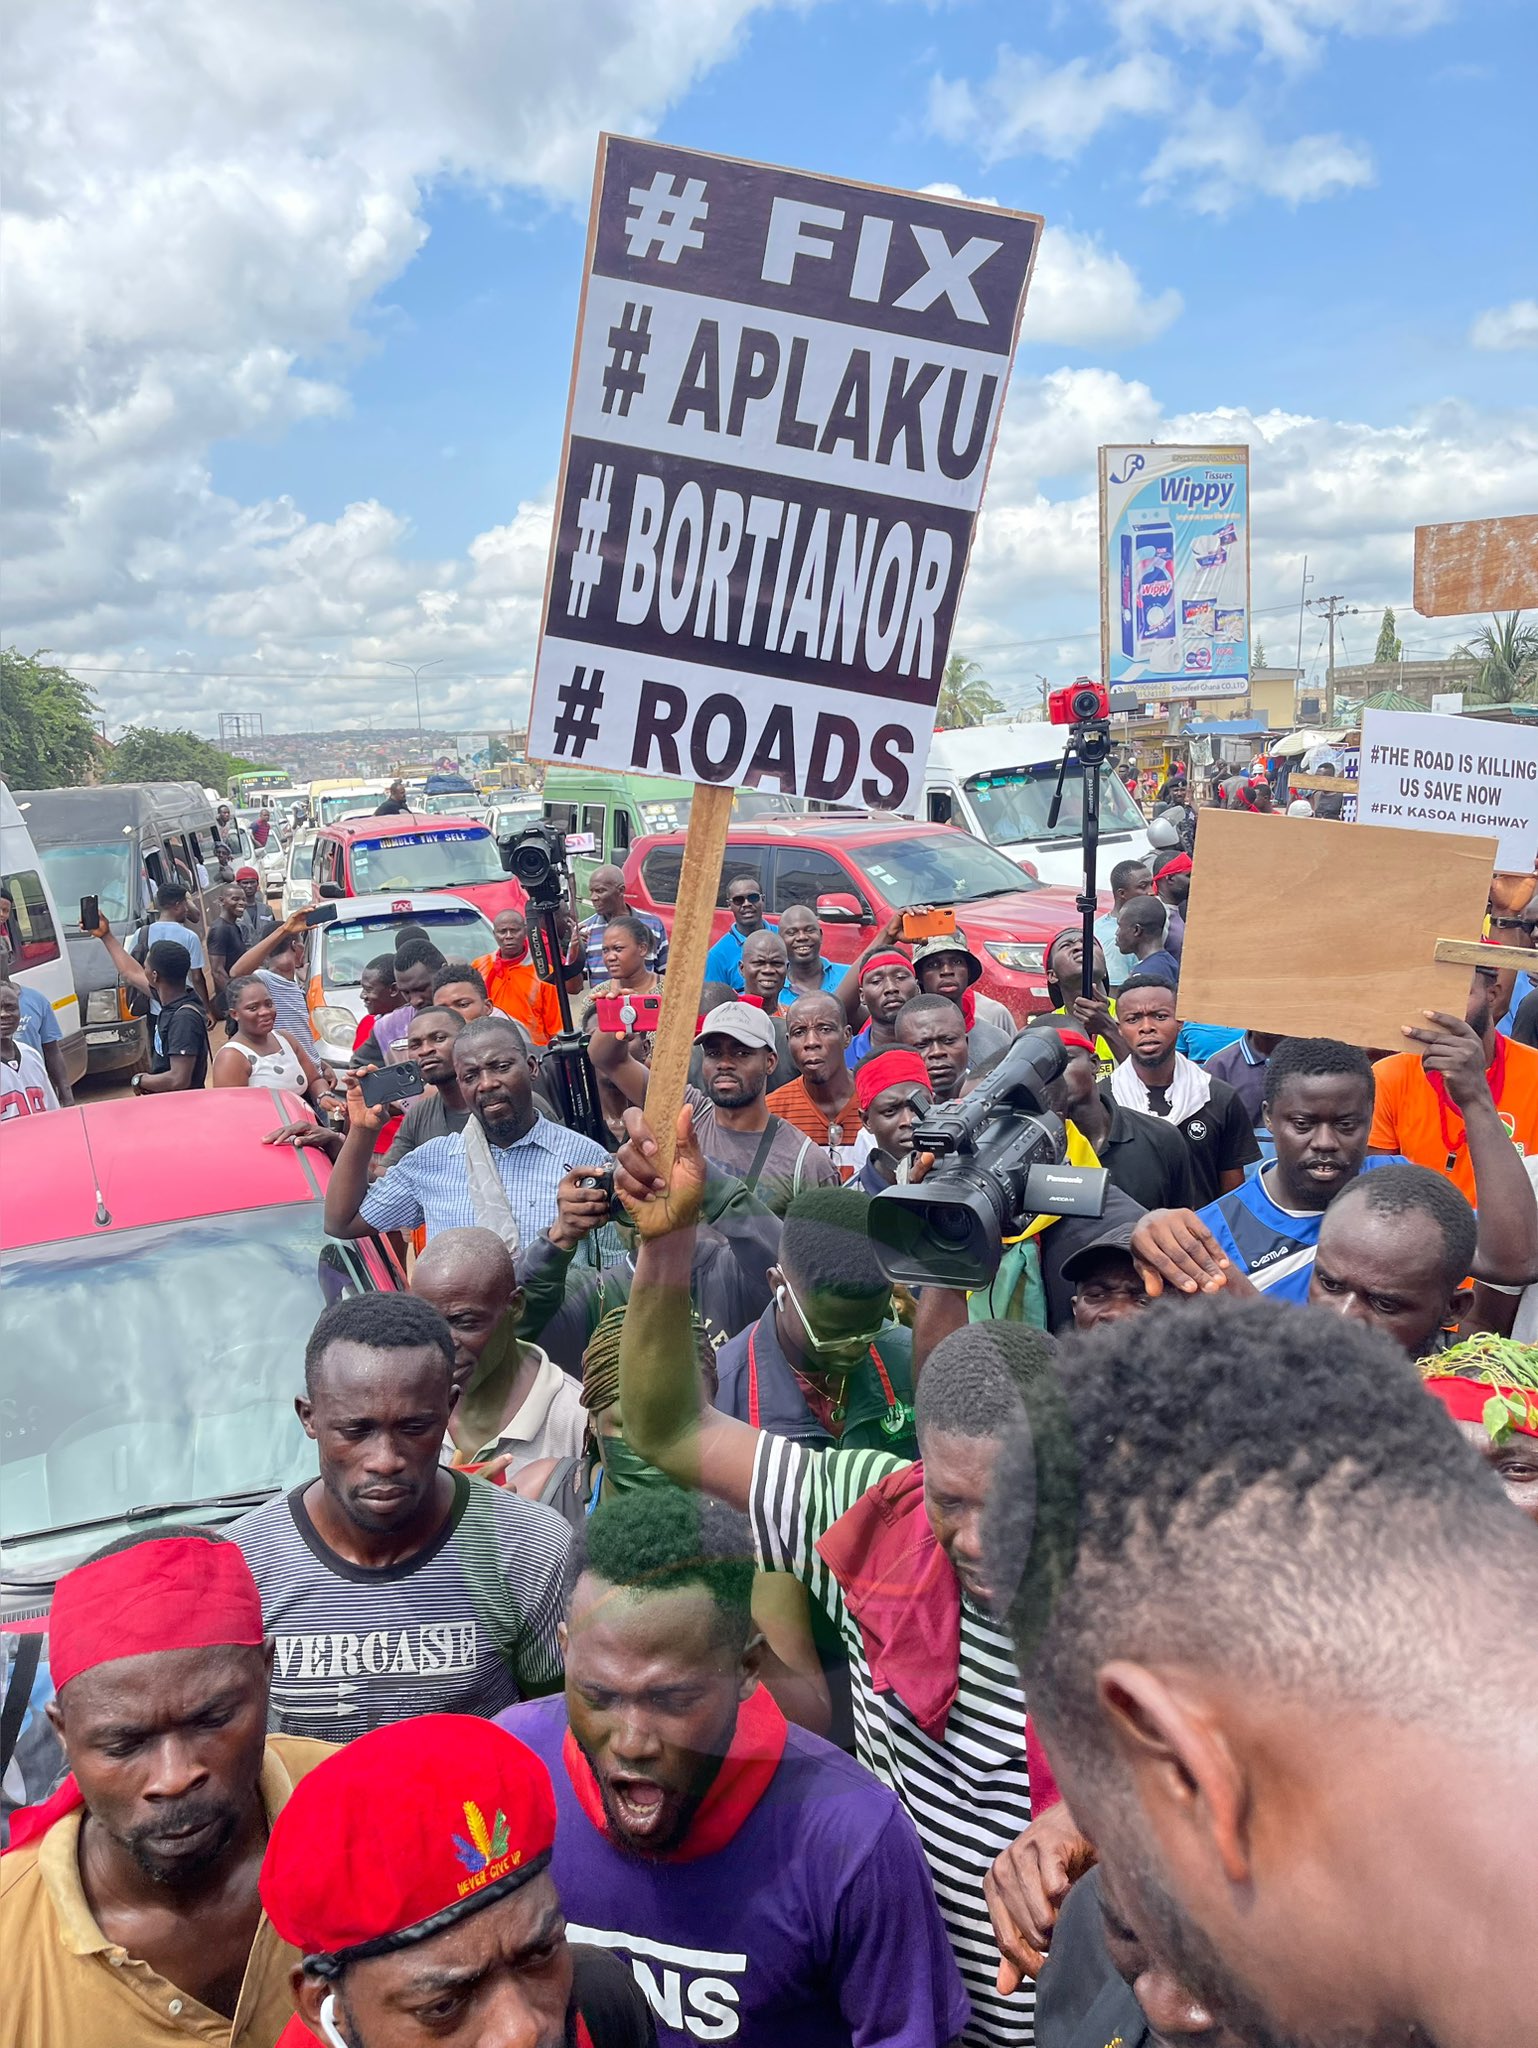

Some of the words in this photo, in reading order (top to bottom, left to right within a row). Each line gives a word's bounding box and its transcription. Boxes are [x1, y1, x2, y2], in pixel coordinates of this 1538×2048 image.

[624, 172, 709, 263] #
[760, 196, 1003, 325] FIX
[600, 301, 653, 417] #
[668, 319, 998, 480] APLAKU
[1205, 471, 1233, 480] Tissues
[1160, 477, 1235, 508] Wippy
[1142, 583, 1171, 596] Wippy
[1201, 684, 1220, 692] Ghana
[553, 665, 605, 758] #
[630, 678, 914, 811] ROADS
[1371, 744, 1409, 767] #THE
[1414, 749, 1454, 771] ROAD
[1459, 754, 1473, 773] IS
[1477, 756, 1537, 780] KILLING
[1400, 778, 1419, 798] US
[1424, 780, 1462, 802] SAVE
[1467, 785, 1502, 806] NOW
[1371, 802, 1403, 816] #FIX
[1407, 806, 1456, 821] KASOA
[1461, 812, 1529, 829] HIGHWAY
[420, 834, 438, 843] THY
[391, 901, 413, 912] TAXI
[1046, 1174, 1084, 1184] Panasonic
[456, 1869, 487, 1897] NEVER
[489, 1858, 510, 1878] GIVE
[511, 1850, 521, 1866] UP
[631, 1957, 740, 2040] NS
